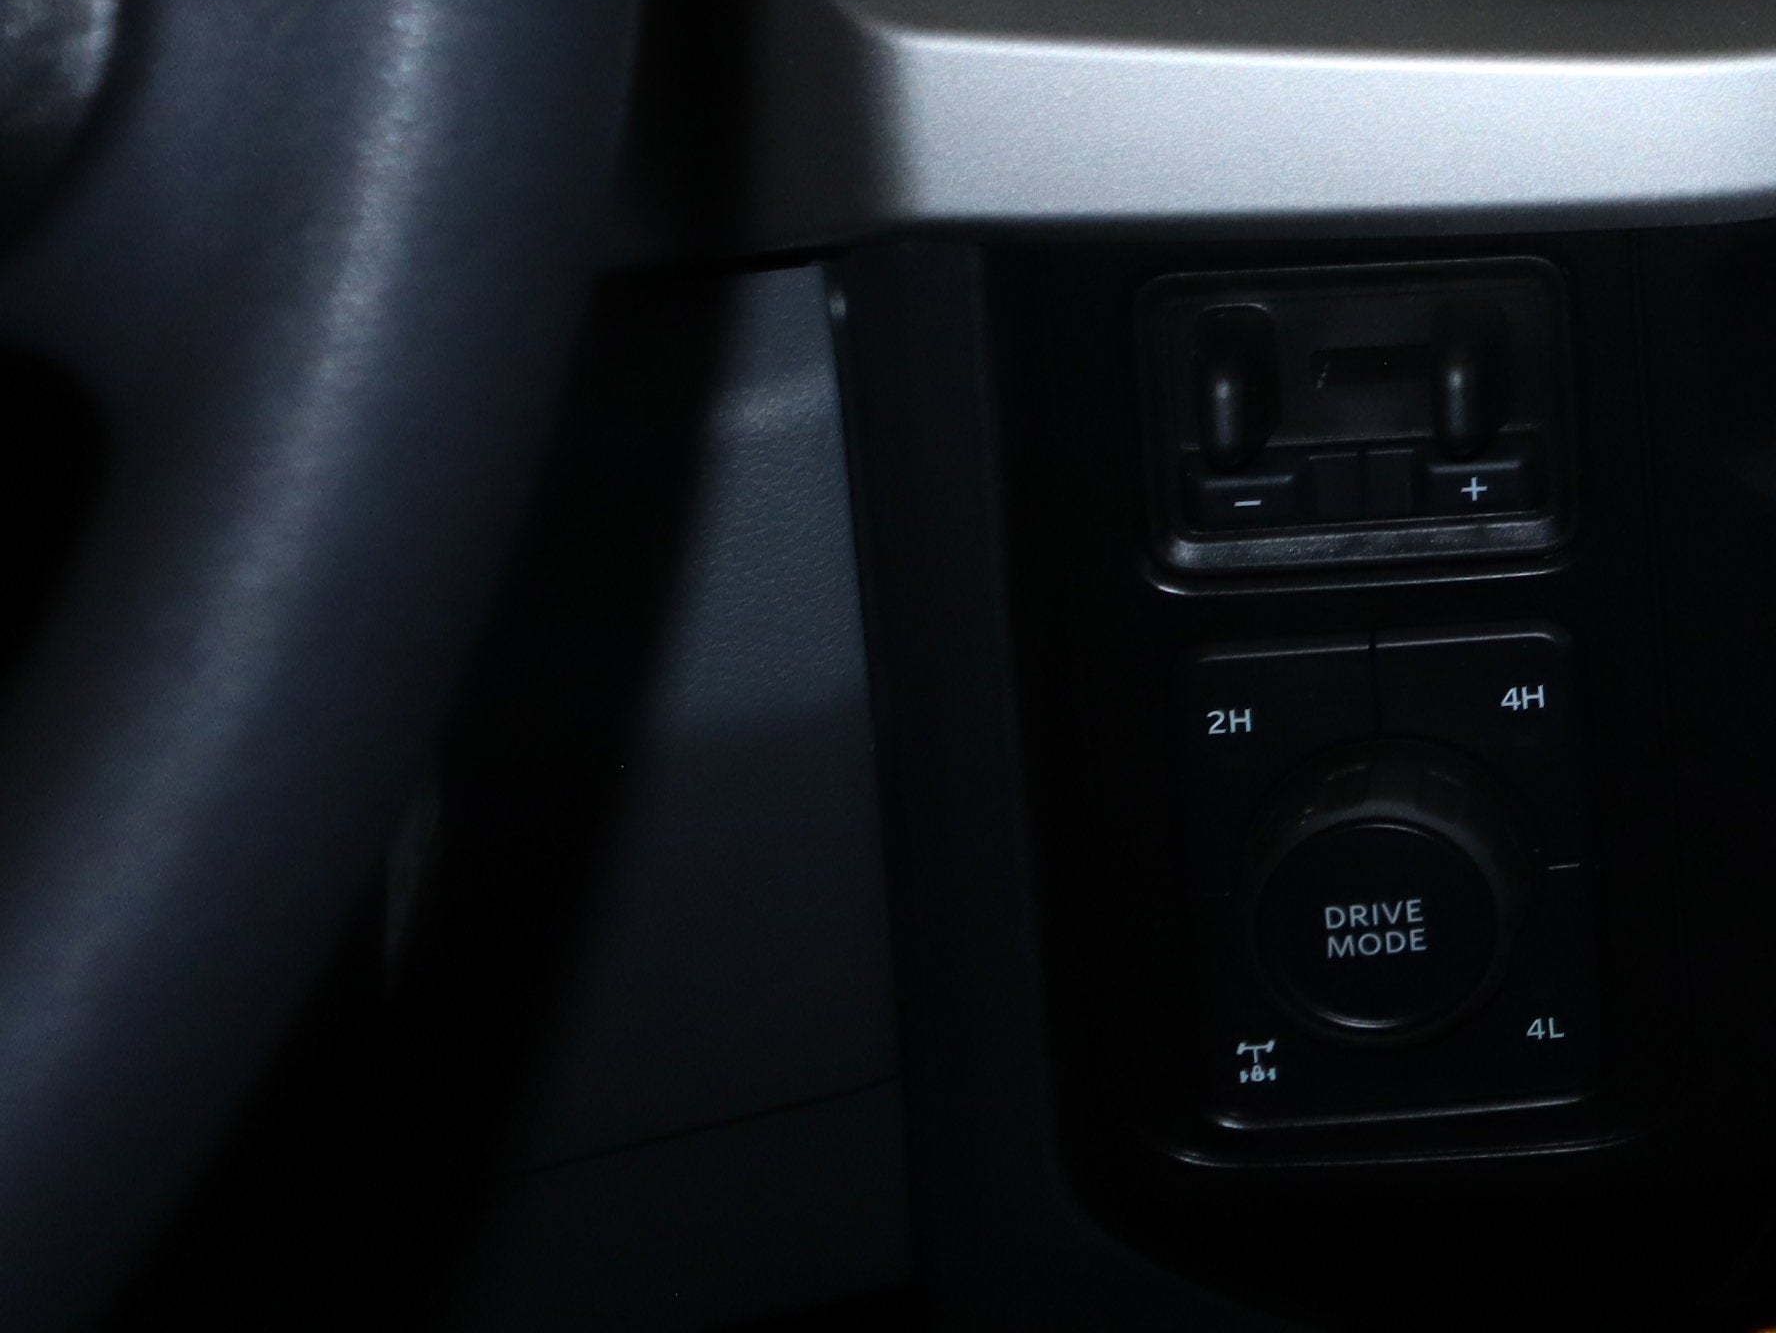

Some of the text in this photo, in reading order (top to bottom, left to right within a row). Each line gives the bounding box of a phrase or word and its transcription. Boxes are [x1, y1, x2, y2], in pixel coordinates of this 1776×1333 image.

[1499, 684, 1547, 713] 4H
[1206, 707, 1253, 736] 2H
[1324, 897, 1425, 931] DRIVE
[1325, 926, 1428, 959] MODE
[1526, 1017, 1566, 1043] 4L
